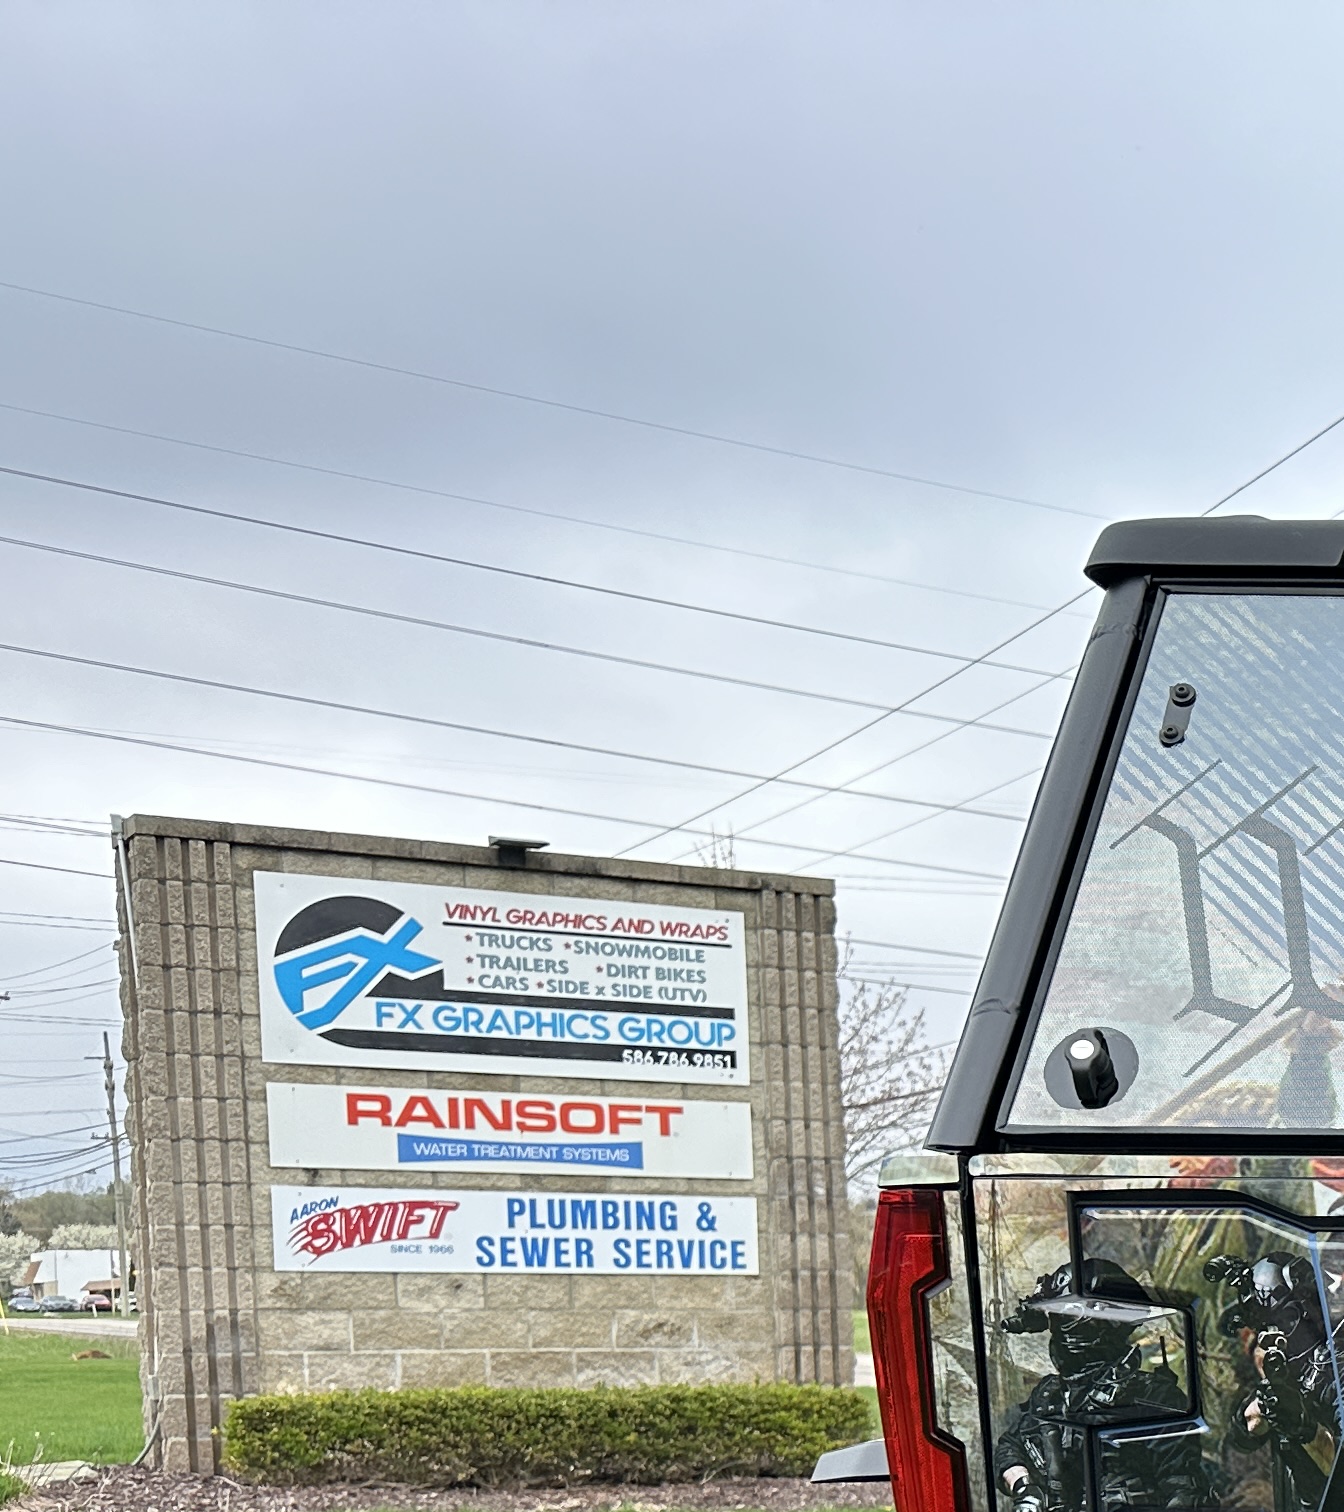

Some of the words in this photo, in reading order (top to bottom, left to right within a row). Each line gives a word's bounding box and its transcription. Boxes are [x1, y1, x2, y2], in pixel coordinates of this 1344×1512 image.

[445, 903, 500, 923] VINYL
[506, 908, 608, 931] GRAPHICS
[611, 917, 654, 935] AND
[659, 920, 729, 941] WRAPS
[475, 932, 553, 952] TRUCKS
[573, 940, 706, 963] SNOWMOBILE
[476, 954, 569, 974] TRAILERS
[606, 963, 651, 981] DIRT
[655, 966, 707, 984] BIKES
[478, 974, 529, 991] CARS
[546, 979, 590, 996] SIDE
[611, 983, 653, 1000] SIDE
[658, 986, 708, 1003] (UTV)
[375, 1001, 424, 1030] FX
[432, 1005, 610, 1041] GRAPHICS
[618, 1015, 736, 1047] GROUP
[622, 1048, 732, 1069] 586.786.9851
[346, 1093, 683, 1136] RAINSOFT
[413, 1142, 467, 1157] WATER
[472, 1144, 560, 1160] TREATMENT
[562, 1147, 629, 1162] SYSTEMS
[290, 1196, 339, 1224] AARON
[507, 1198, 677, 1231] PLUMBING
[696, 1202, 717, 1232] &
[300, 1201, 460, 1258] SWIFT
[390, 1244, 422, 1254] SINCE
[476, 1236, 594, 1268] SEWER
[613, 1238, 747, 1270] SERVICE
